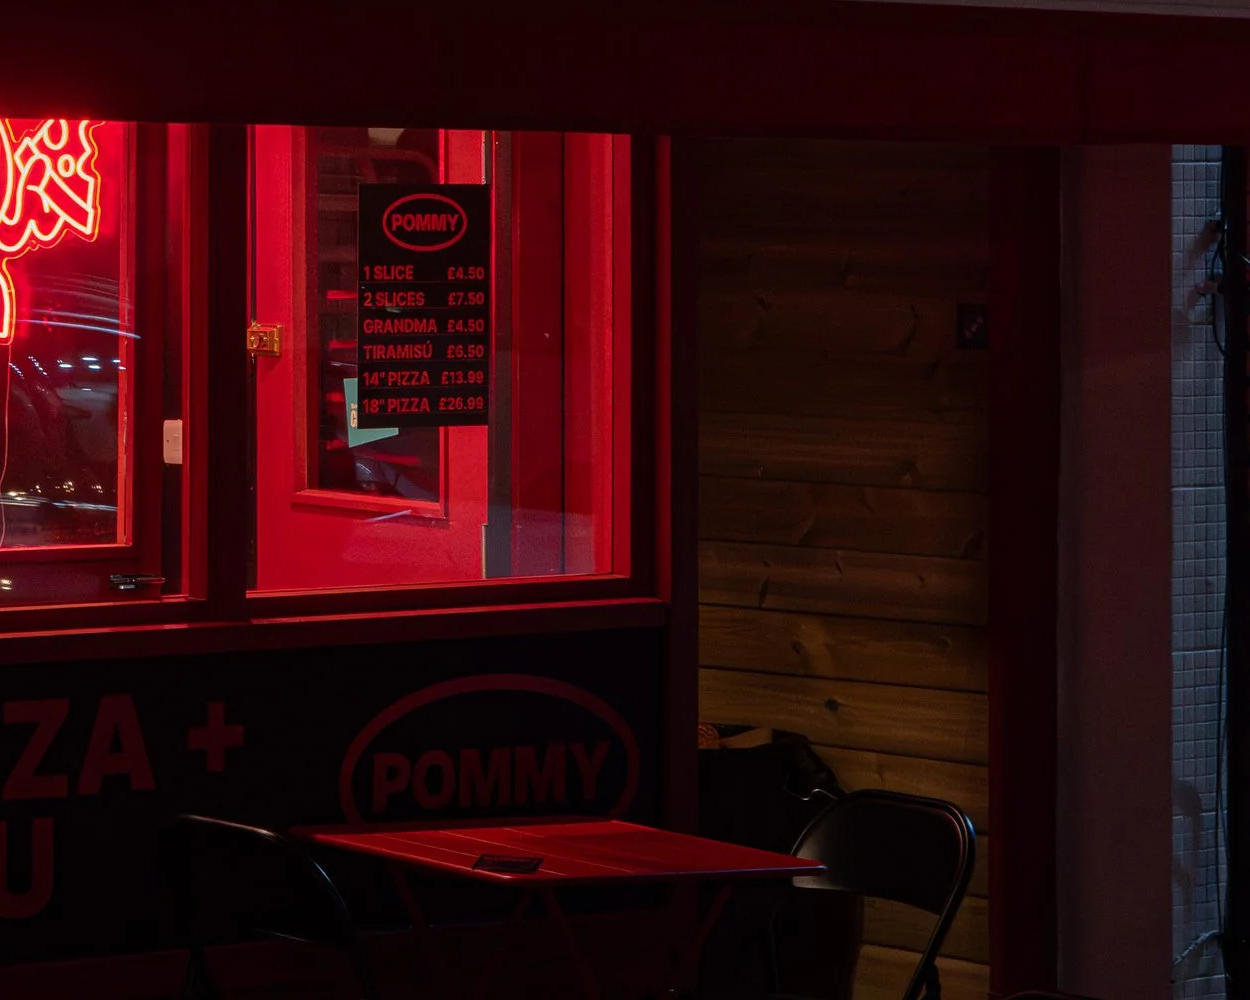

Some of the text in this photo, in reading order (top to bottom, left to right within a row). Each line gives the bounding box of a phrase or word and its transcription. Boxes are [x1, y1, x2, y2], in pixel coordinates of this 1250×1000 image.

[391, 213, 460, 233] POMMY
[363, 265, 485, 280] 1 SLICE £4.50
[363, 292, 485, 307] 2 SLICES £7.50
[363, 318, 485, 334] GRANDMA £4.50
[446, 344, 485, 359] £6.50
[388, 371, 430, 386] PIZZA
[440, 370, 484, 385] £13.99
[387, 398, 431, 413] PIZZA
[437, 396, 485, 411] £26.99
[371, 740, 612, 814] POMMY
